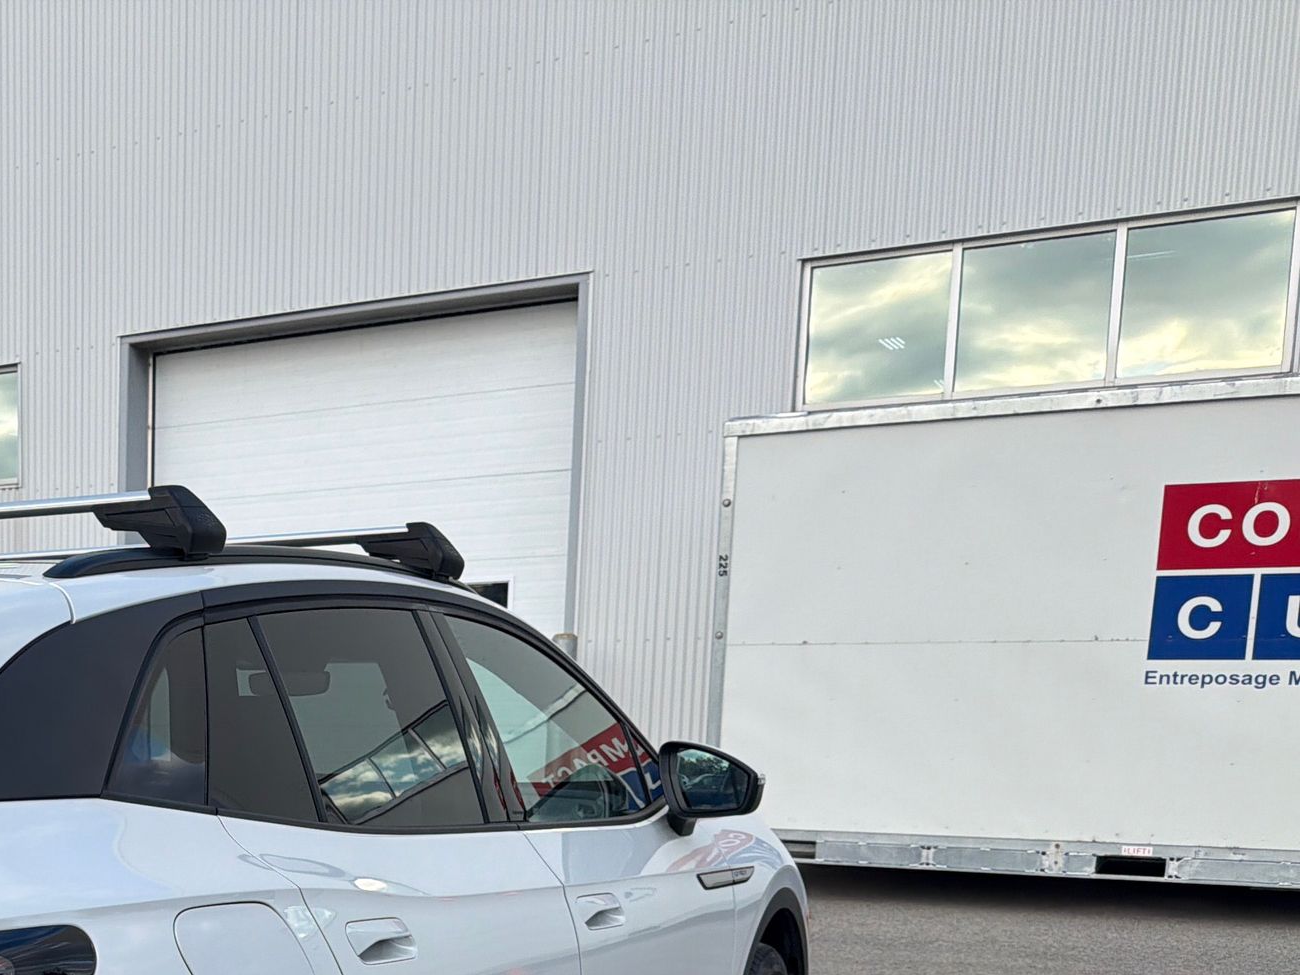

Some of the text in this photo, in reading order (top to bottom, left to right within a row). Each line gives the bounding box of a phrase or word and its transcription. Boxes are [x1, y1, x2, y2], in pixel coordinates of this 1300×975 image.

[1187, 501, 1291, 548] CO
[718, 554, 728, 577] 225
[1144, 671, 1280, 689] Entreposage
